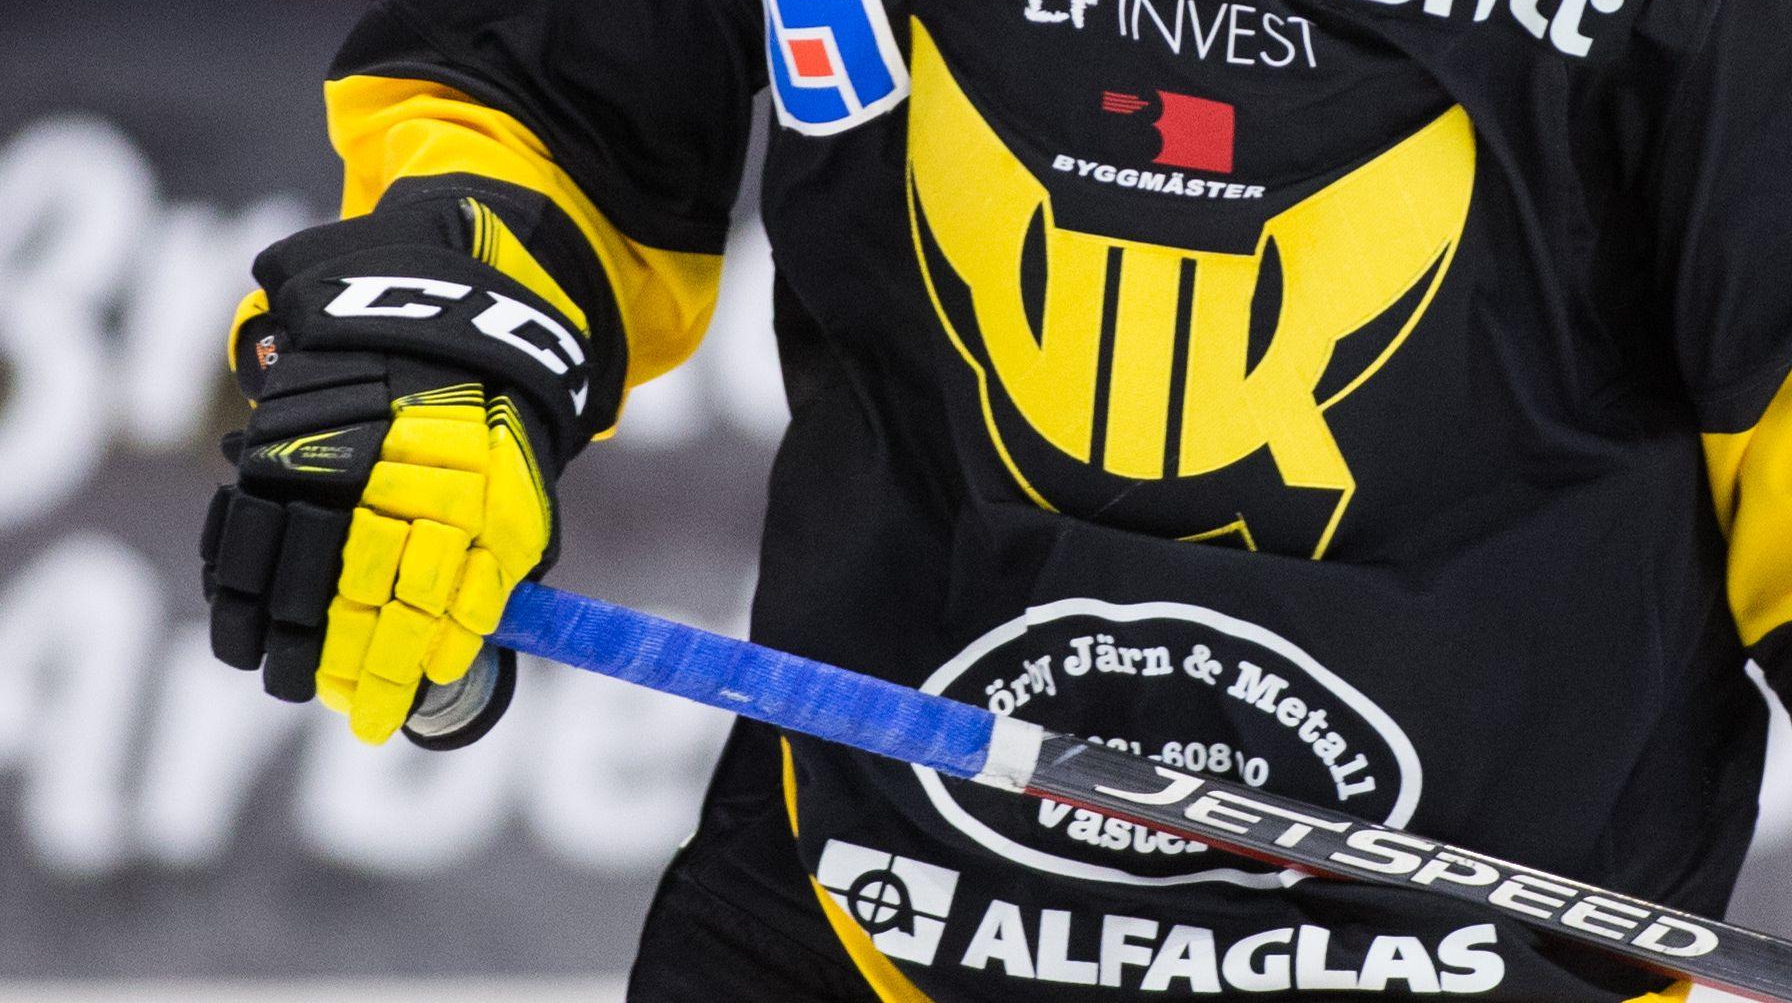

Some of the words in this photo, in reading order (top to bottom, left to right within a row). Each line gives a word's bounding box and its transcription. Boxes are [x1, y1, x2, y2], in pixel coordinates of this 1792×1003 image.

[1051, 153, 1267, 200] BYGGMÄSTER
[323, 275, 590, 418] CC
[1062, 633, 1173, 678] Järn
[1182, 643, 1224, 687] &
[1226, 660, 1377, 802] Metall
[1094, 765, 1720, 958] JETSPEED
[960, 899, 1506, 995] ALFAGLAS
